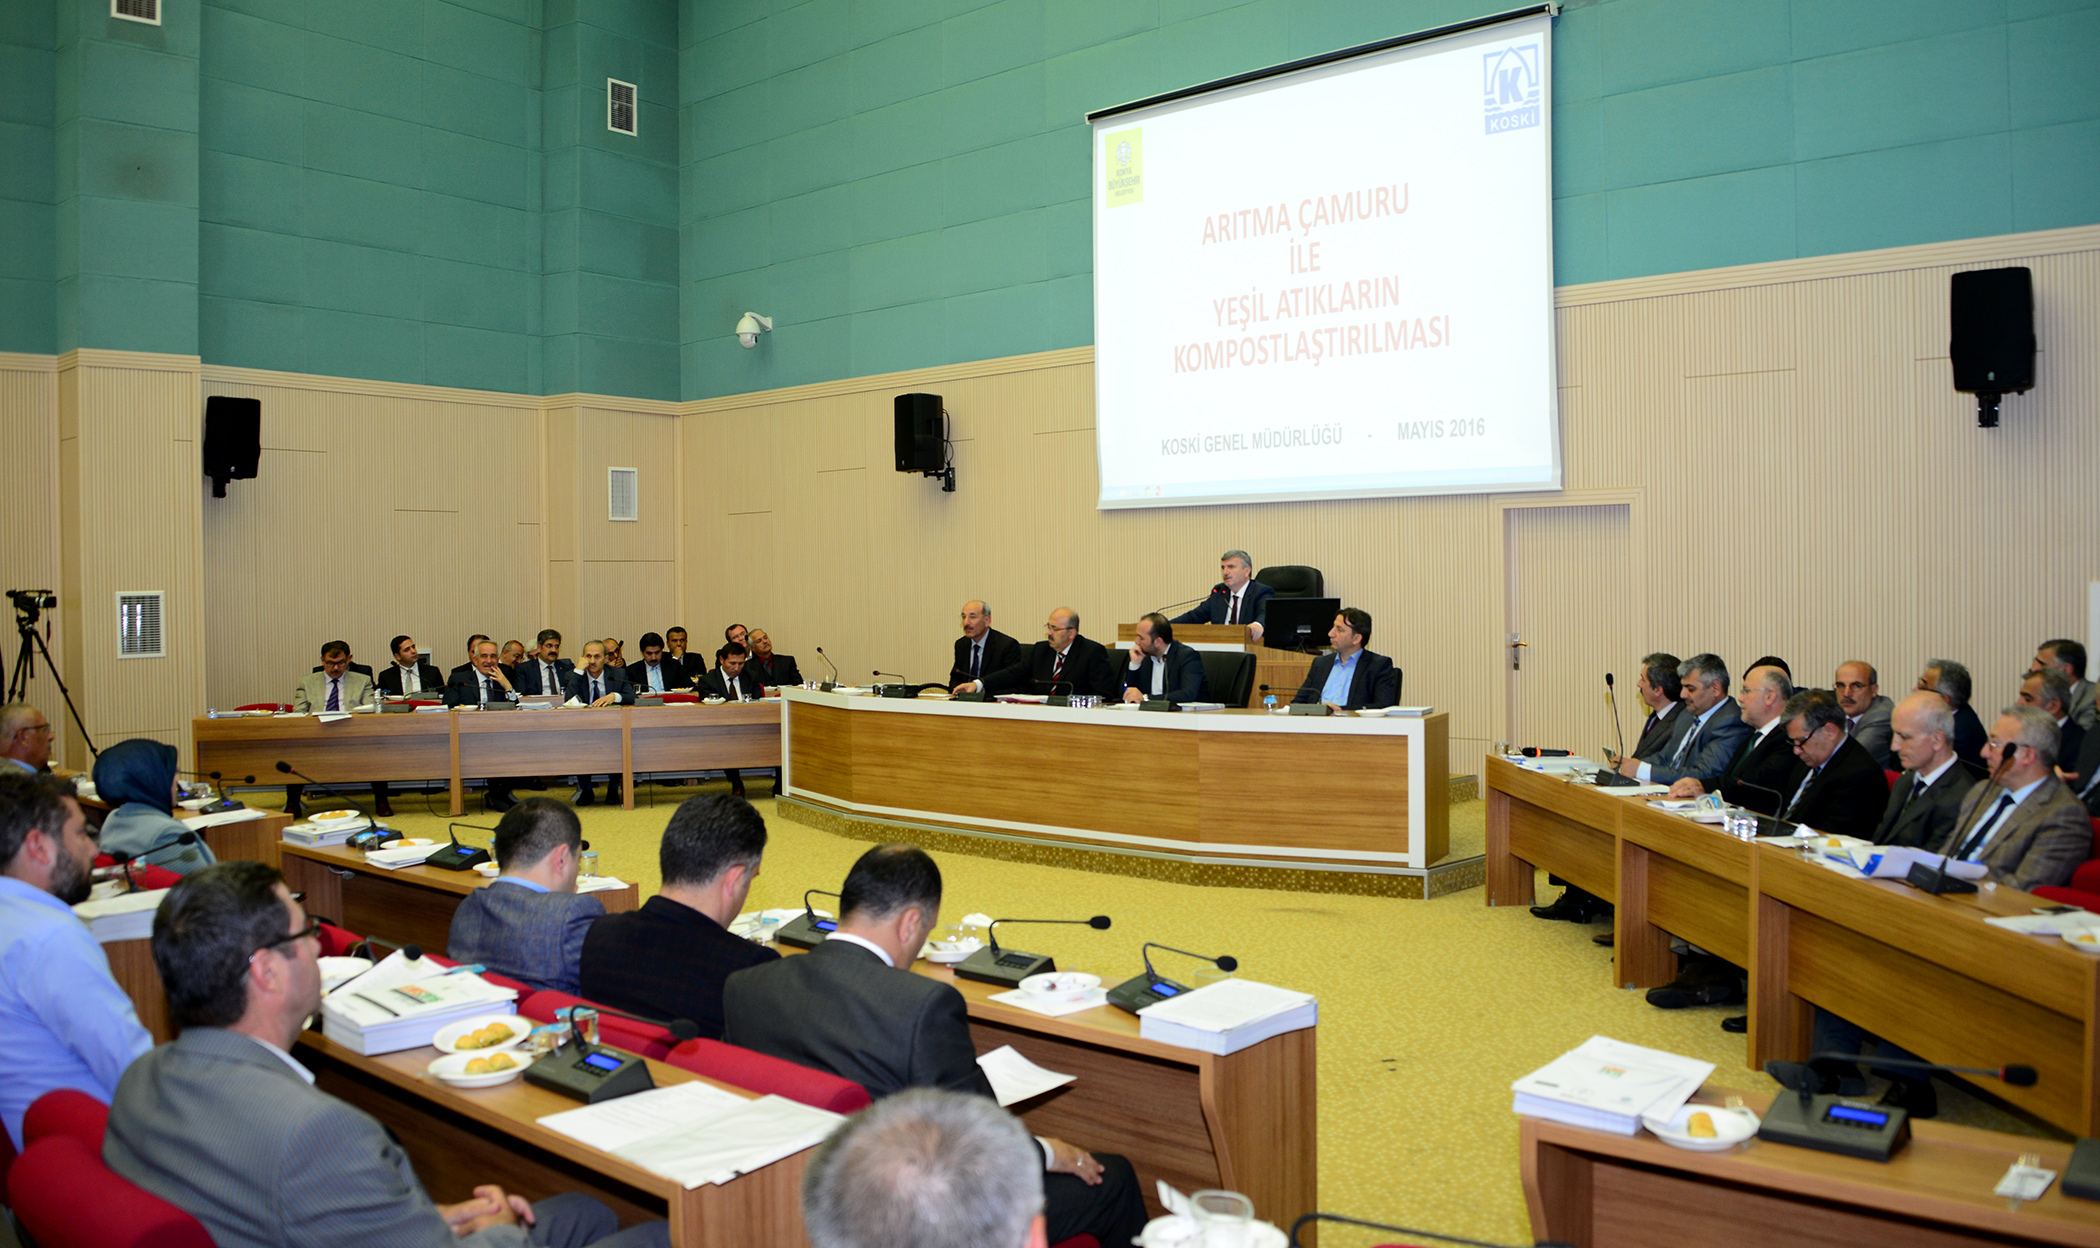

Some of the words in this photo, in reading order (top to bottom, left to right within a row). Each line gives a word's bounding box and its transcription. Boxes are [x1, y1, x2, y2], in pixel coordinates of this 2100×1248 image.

[1498, 65, 1525, 106] K
[1489, 108, 1536, 133] KOSKİ
[1202, 203, 1292, 246] ARITMA
[1297, 182, 1410, 237] ÇAMURU
[1289, 237, 1321, 275] İLE
[1212, 286, 1270, 332] YEŞİL
[1275, 275, 1400, 320] ATIKLARIN
[1174, 314, 1450, 374] KOMPOSTLAŞTIRILMASI
[1161, 432, 1200, 456] KOSKİ
[1204, 433, 1248, 453] GENEL
[1252, 422, 1342, 449] MÜDÜRLÜĞÜ
[1397, 419, 1445, 441] MAYIS
[1449, 417, 1486, 438] 2016
